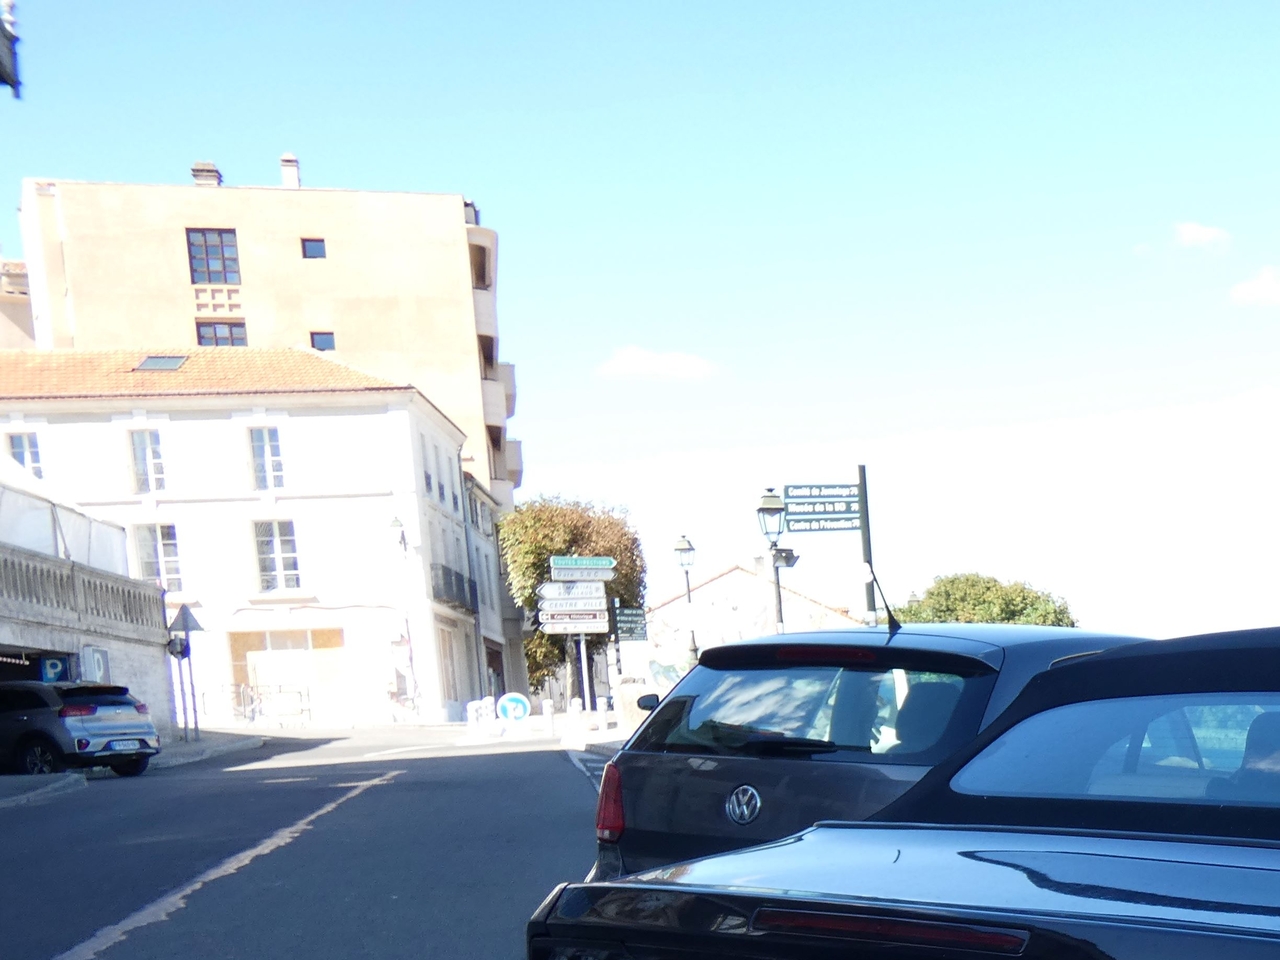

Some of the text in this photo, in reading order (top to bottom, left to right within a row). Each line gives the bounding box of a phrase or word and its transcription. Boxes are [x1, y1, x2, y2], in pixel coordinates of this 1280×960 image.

[811, 487, 820, 496] de
[788, 502, 814, 512] Musée
[814, 502, 824, 512] de
[825, 502, 833, 512] la
[811, 520, 819, 530] de
